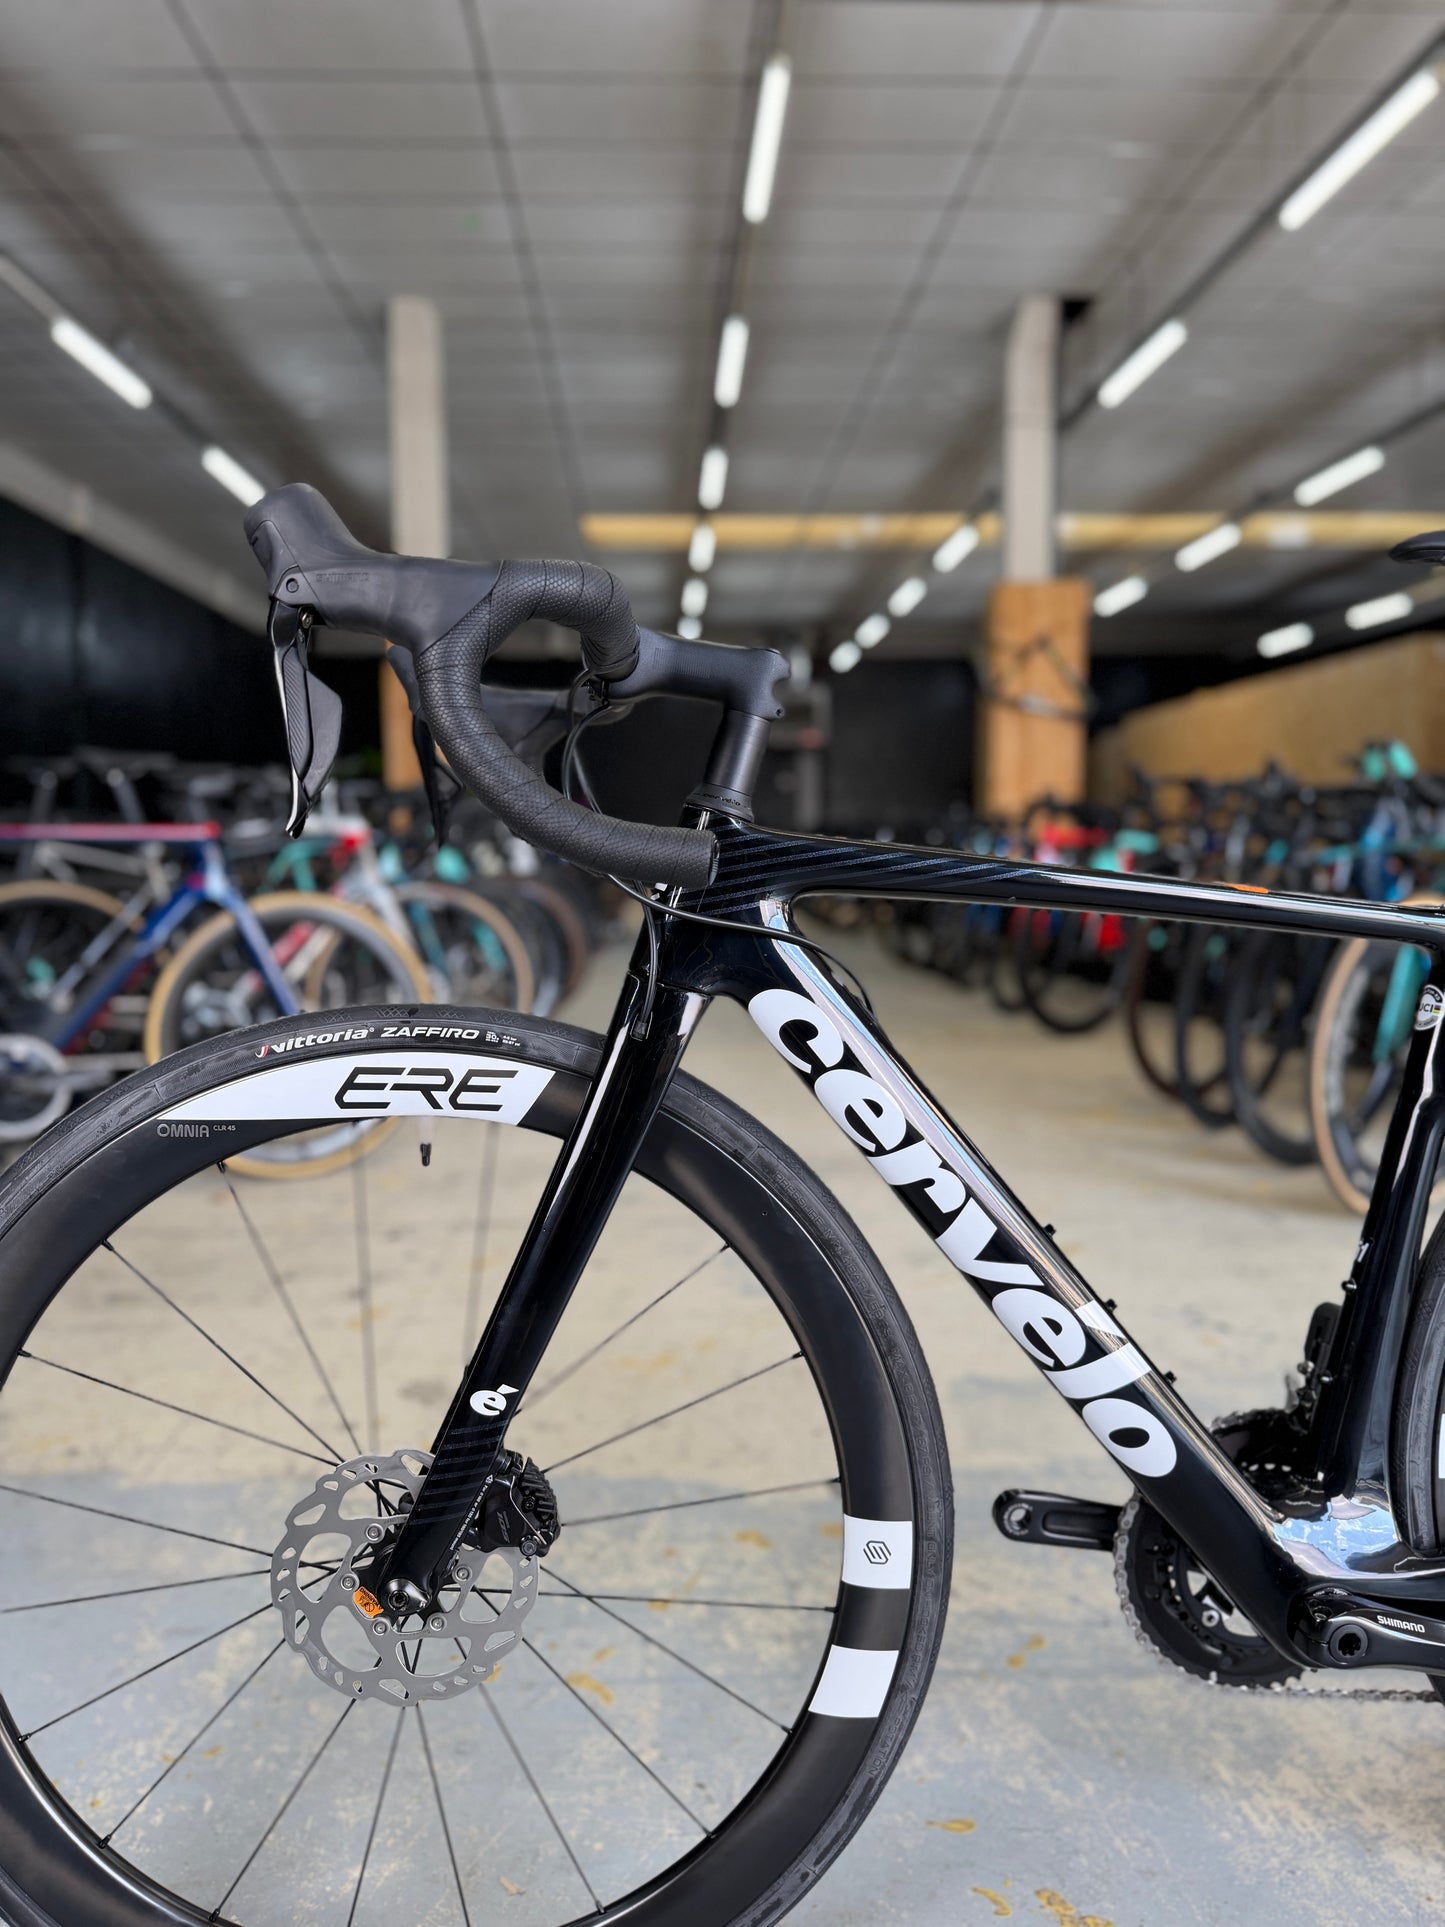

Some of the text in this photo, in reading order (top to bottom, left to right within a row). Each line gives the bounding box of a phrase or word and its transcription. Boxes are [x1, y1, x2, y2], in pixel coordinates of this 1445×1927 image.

[380, 1026, 480, 1040] ZAFFIRO
[334, 1066, 520, 1111] ERE
[156, 1123, 236, 1138] OMNIA CLR 45
[1377, 1614, 1426, 1634] SHIMANO
